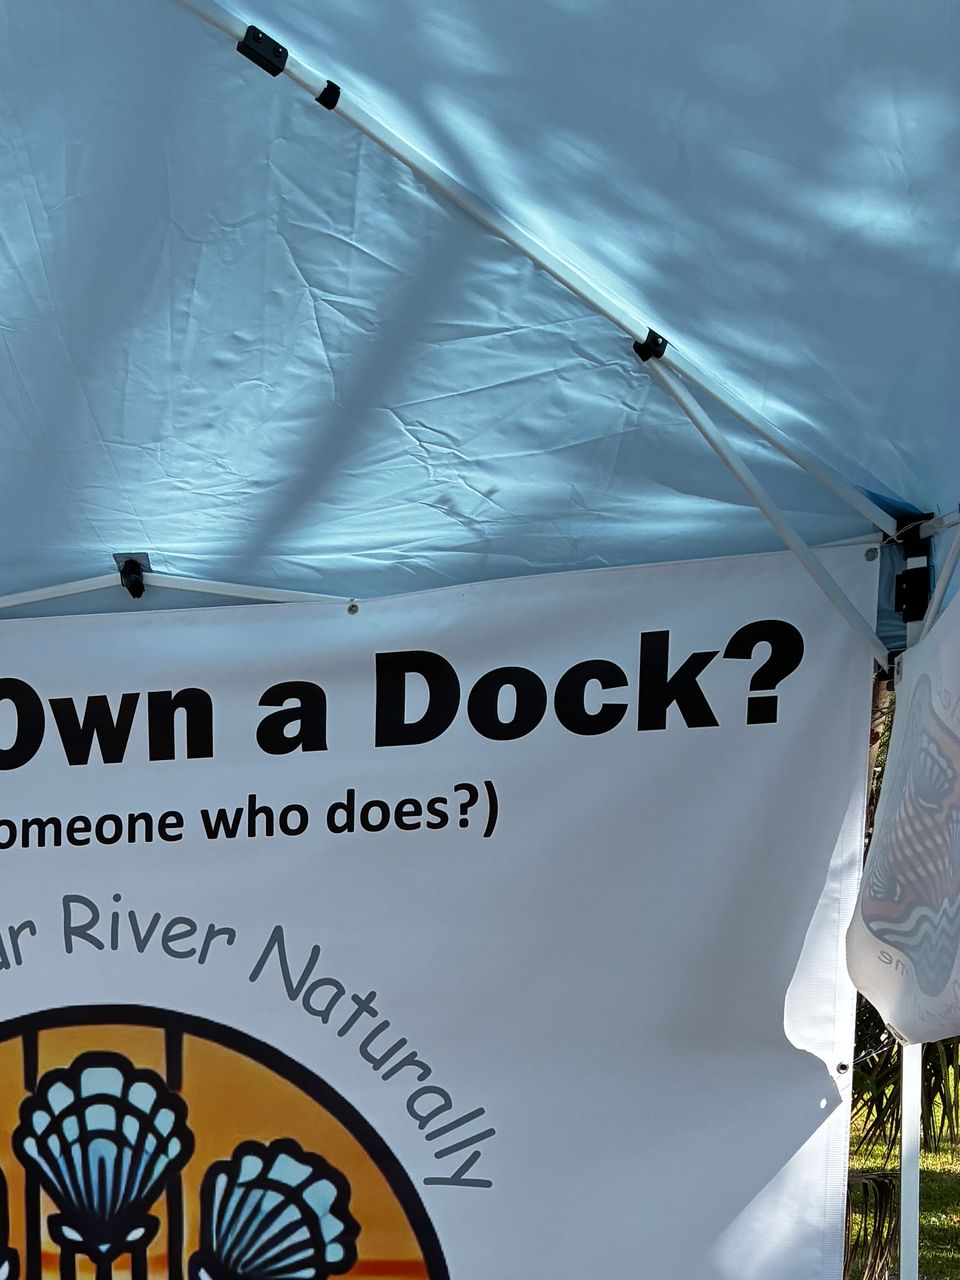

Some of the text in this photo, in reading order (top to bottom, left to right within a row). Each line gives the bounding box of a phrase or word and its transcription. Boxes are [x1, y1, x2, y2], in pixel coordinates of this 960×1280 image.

[255, 680, 328, 757] a
[374, 619, 806, 749] Dock?
[200, 793, 310, 840] who
[324, 779, 500, 838] does?)
[61, 893, 237, 966] River
[248, 924, 497, 1189] Naturally
